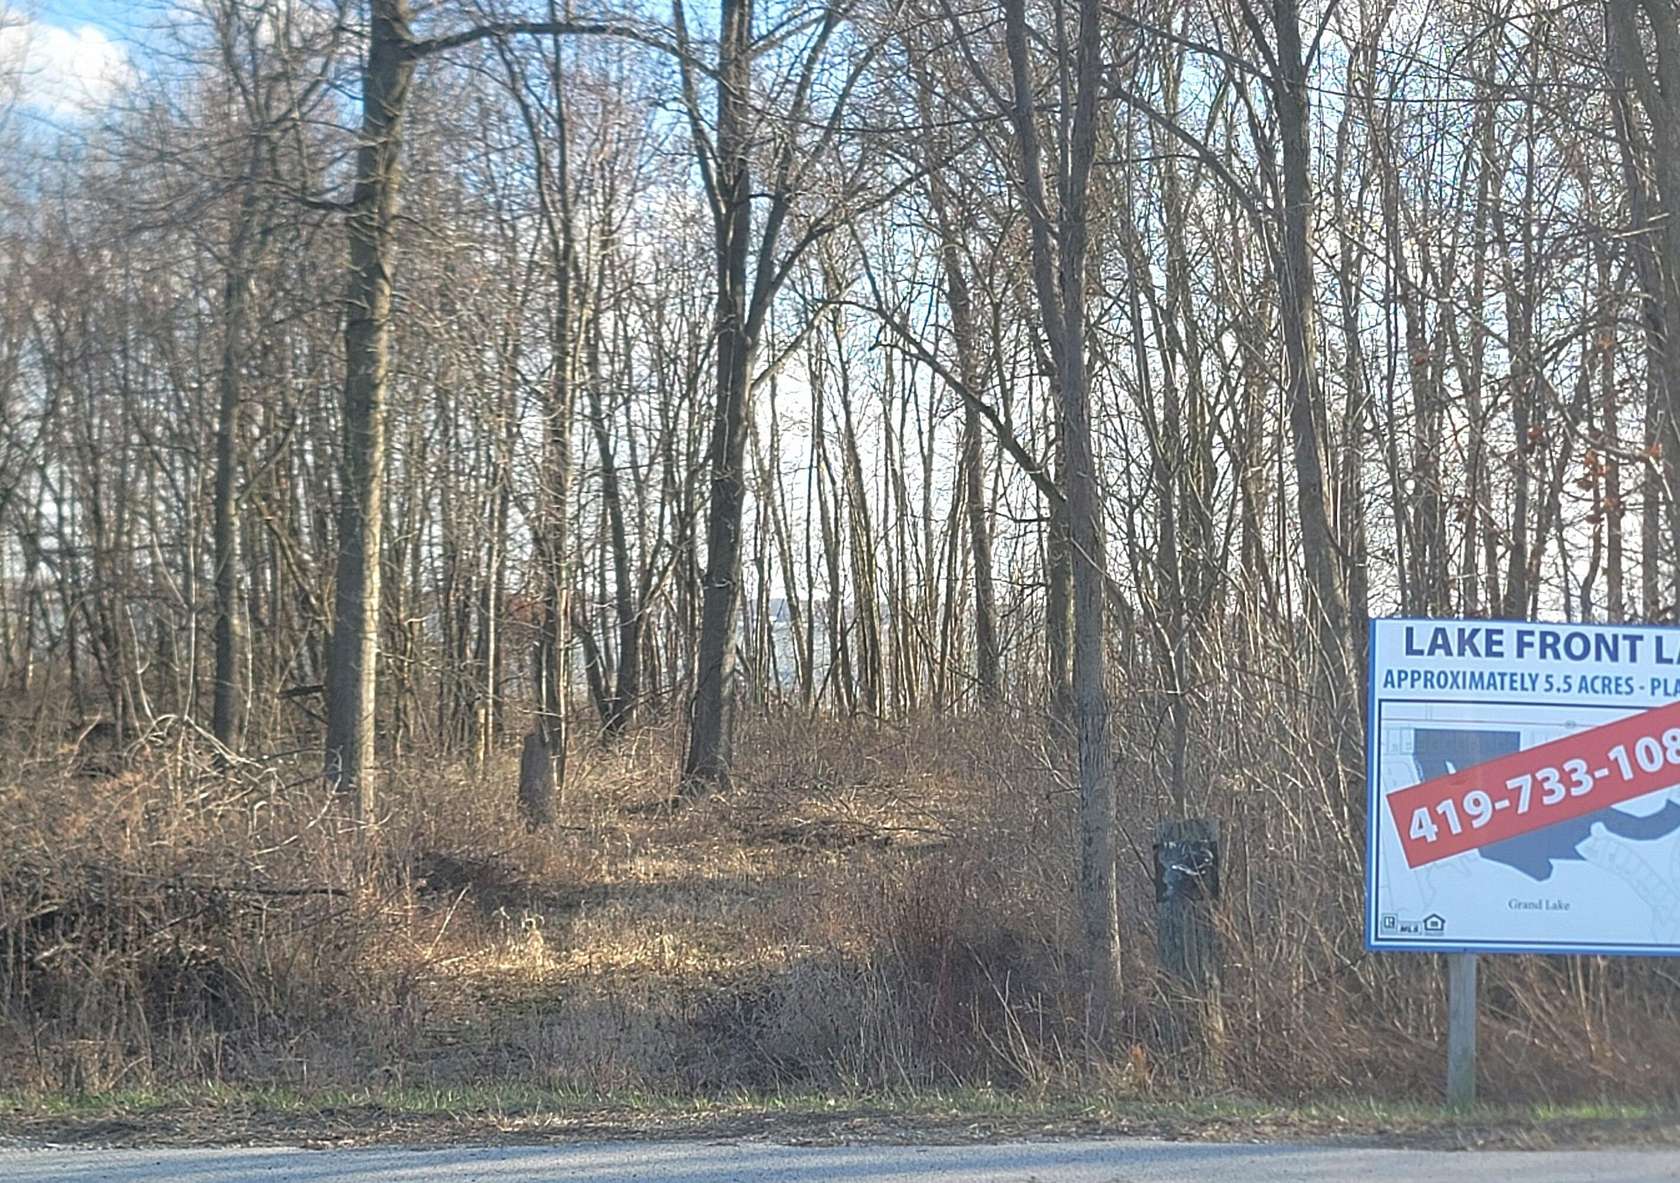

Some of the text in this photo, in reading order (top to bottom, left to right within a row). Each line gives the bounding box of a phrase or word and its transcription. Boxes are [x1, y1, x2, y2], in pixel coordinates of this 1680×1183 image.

[1405, 626, 1680, 664] LAKE FRONT L
[1383, 669, 1539, 692] APPROXIMATELY
[1544, 674, 1572, 693] 5.5
[1577, 675, 1634, 695] ACRES
[1508, 898, 1570, 911] Grand Lake
